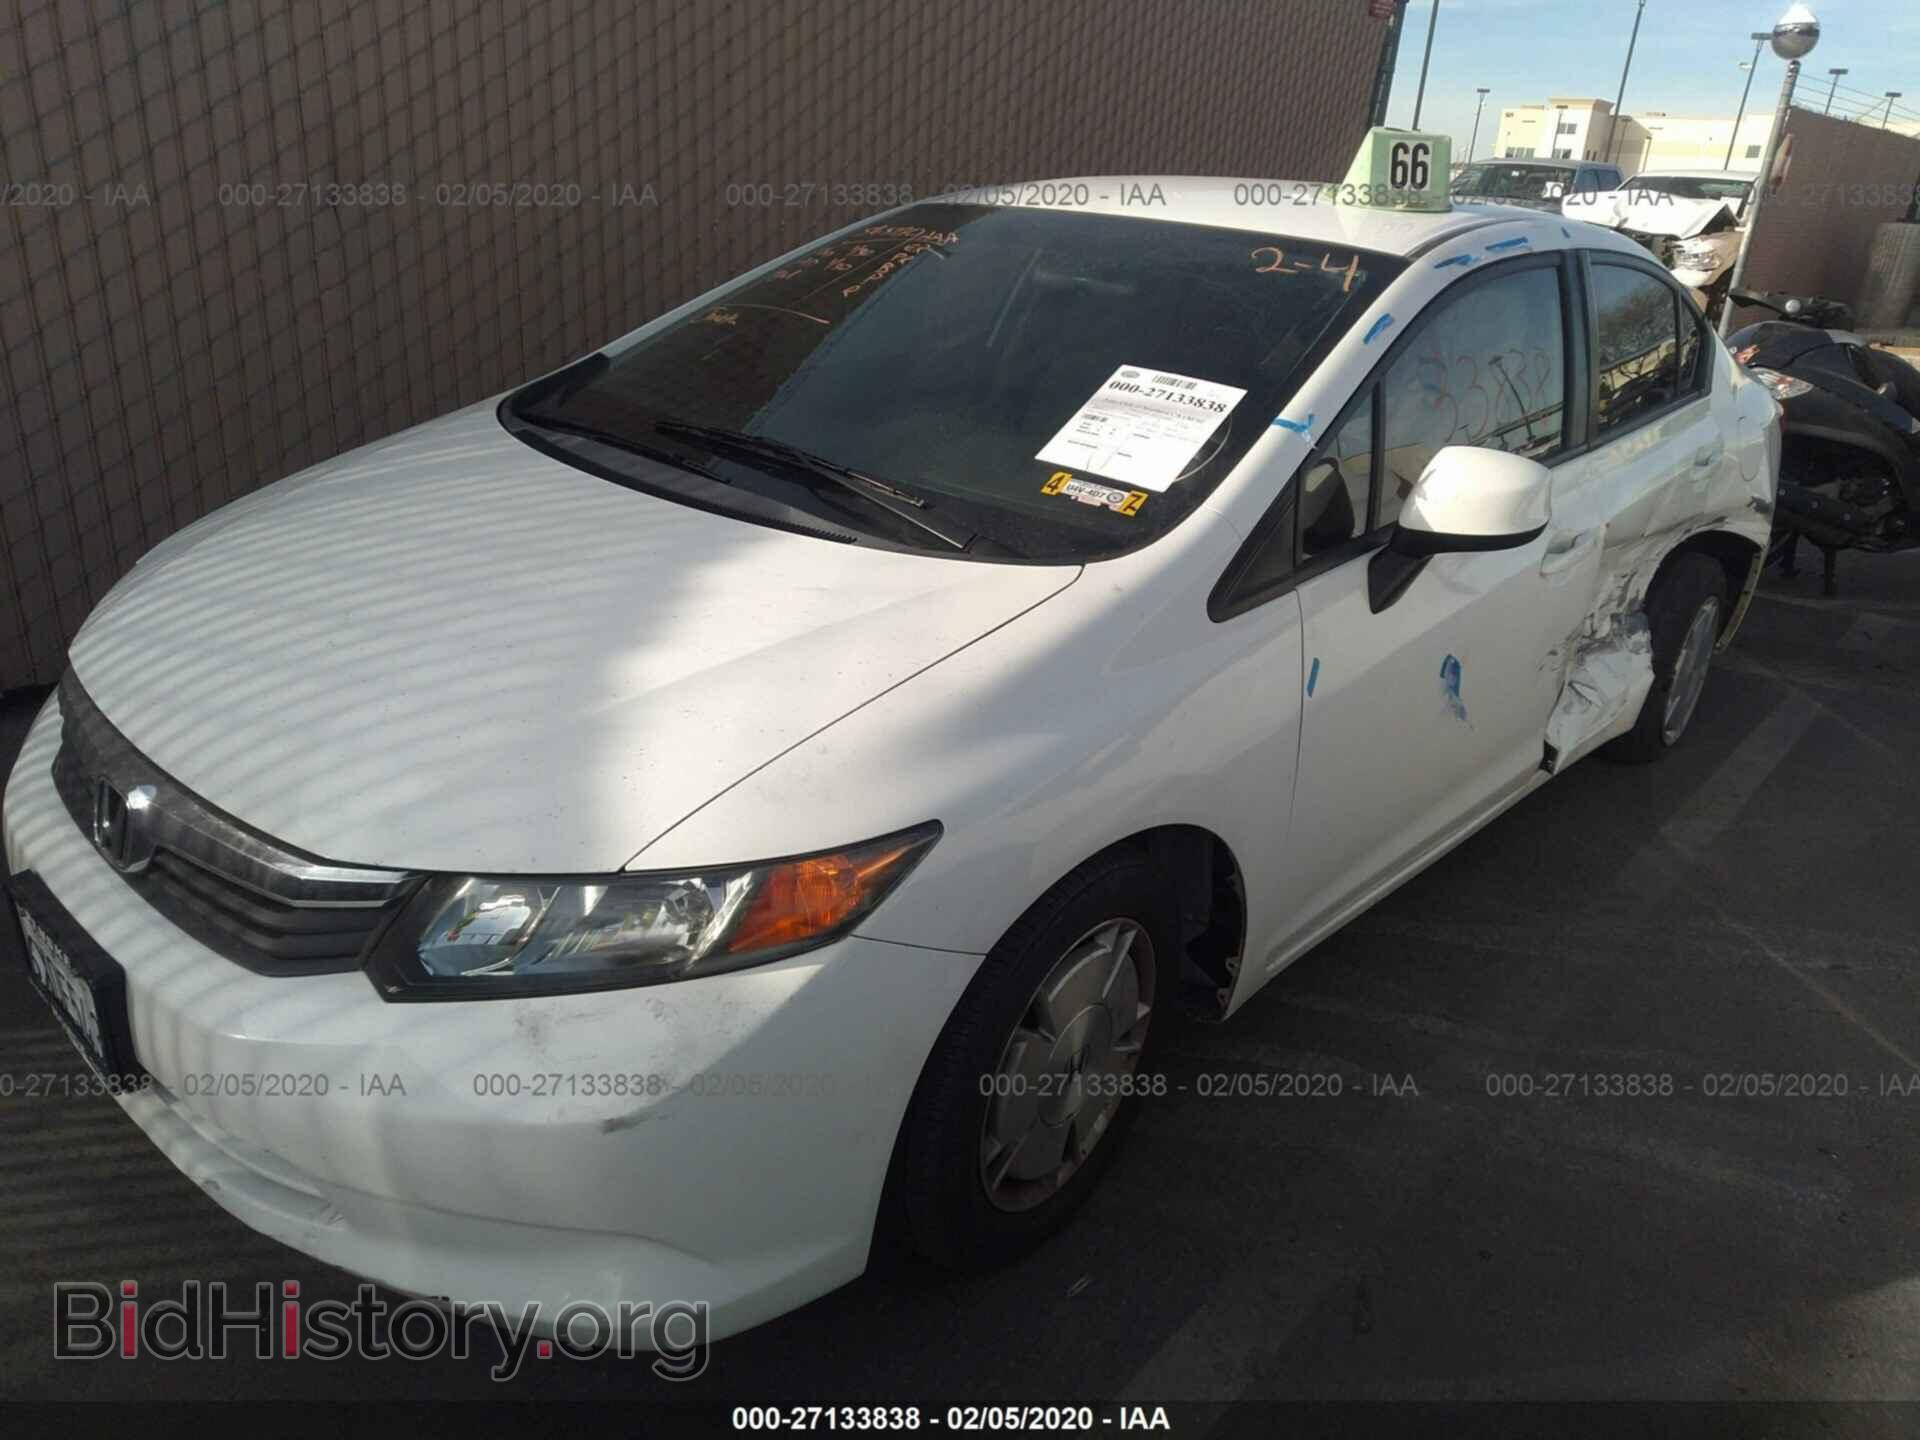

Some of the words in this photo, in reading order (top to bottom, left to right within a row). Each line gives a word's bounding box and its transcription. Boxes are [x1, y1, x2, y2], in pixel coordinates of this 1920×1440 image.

[1389, 141, 1430, 190] 66
[1251, 246, 1360, 292] 2-4
[1109, 380, 1227, 414] 000-27133838
